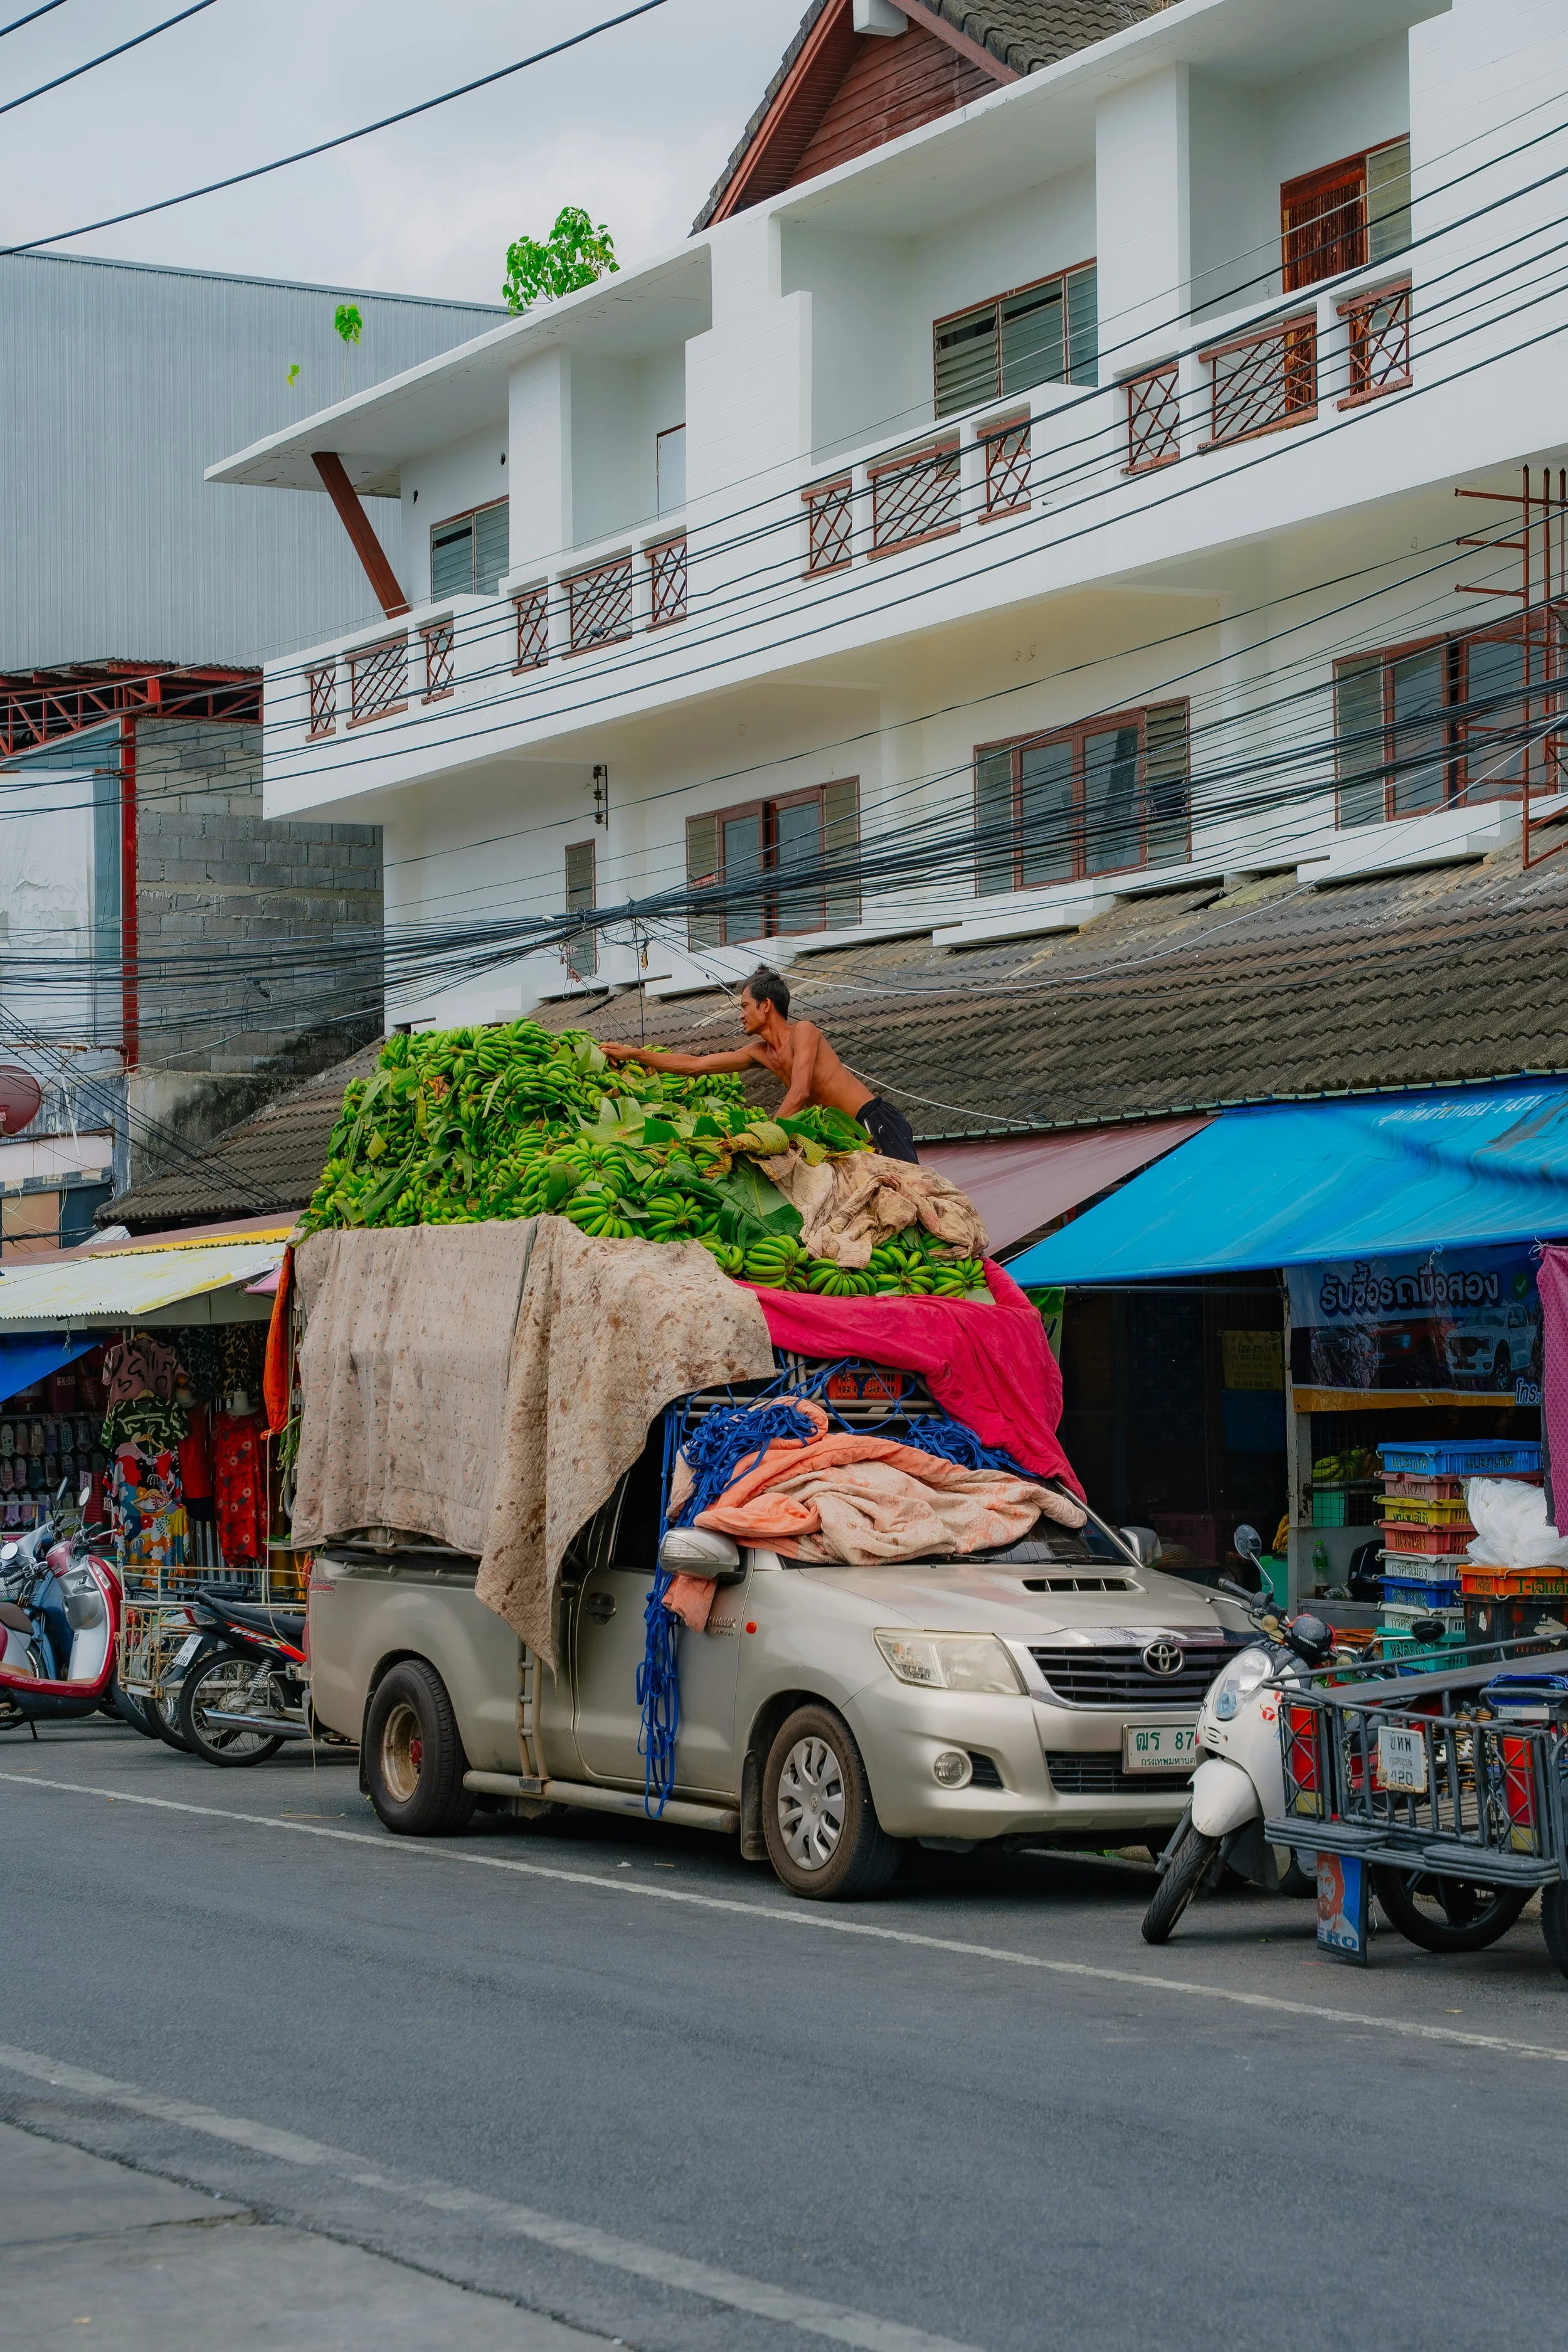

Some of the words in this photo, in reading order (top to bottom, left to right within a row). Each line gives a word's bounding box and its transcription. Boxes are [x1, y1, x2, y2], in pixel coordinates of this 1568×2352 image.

[1322, 1262, 1498, 1310] รับซื้อรถมือสอง
[1516, 1377, 1540, 1404] โทร.
[1394, 1481, 1426, 1496] CARZO
[1392, 1562, 1428, 1578] กรศรีเมือง
[1298, 1634, 1318, 1648] HONDA
[174, 1654, 188, 1665] 5160
[1136, 1732, 1161, 1751] ฒร
[1175, 1731, 1195, 1750] 87
